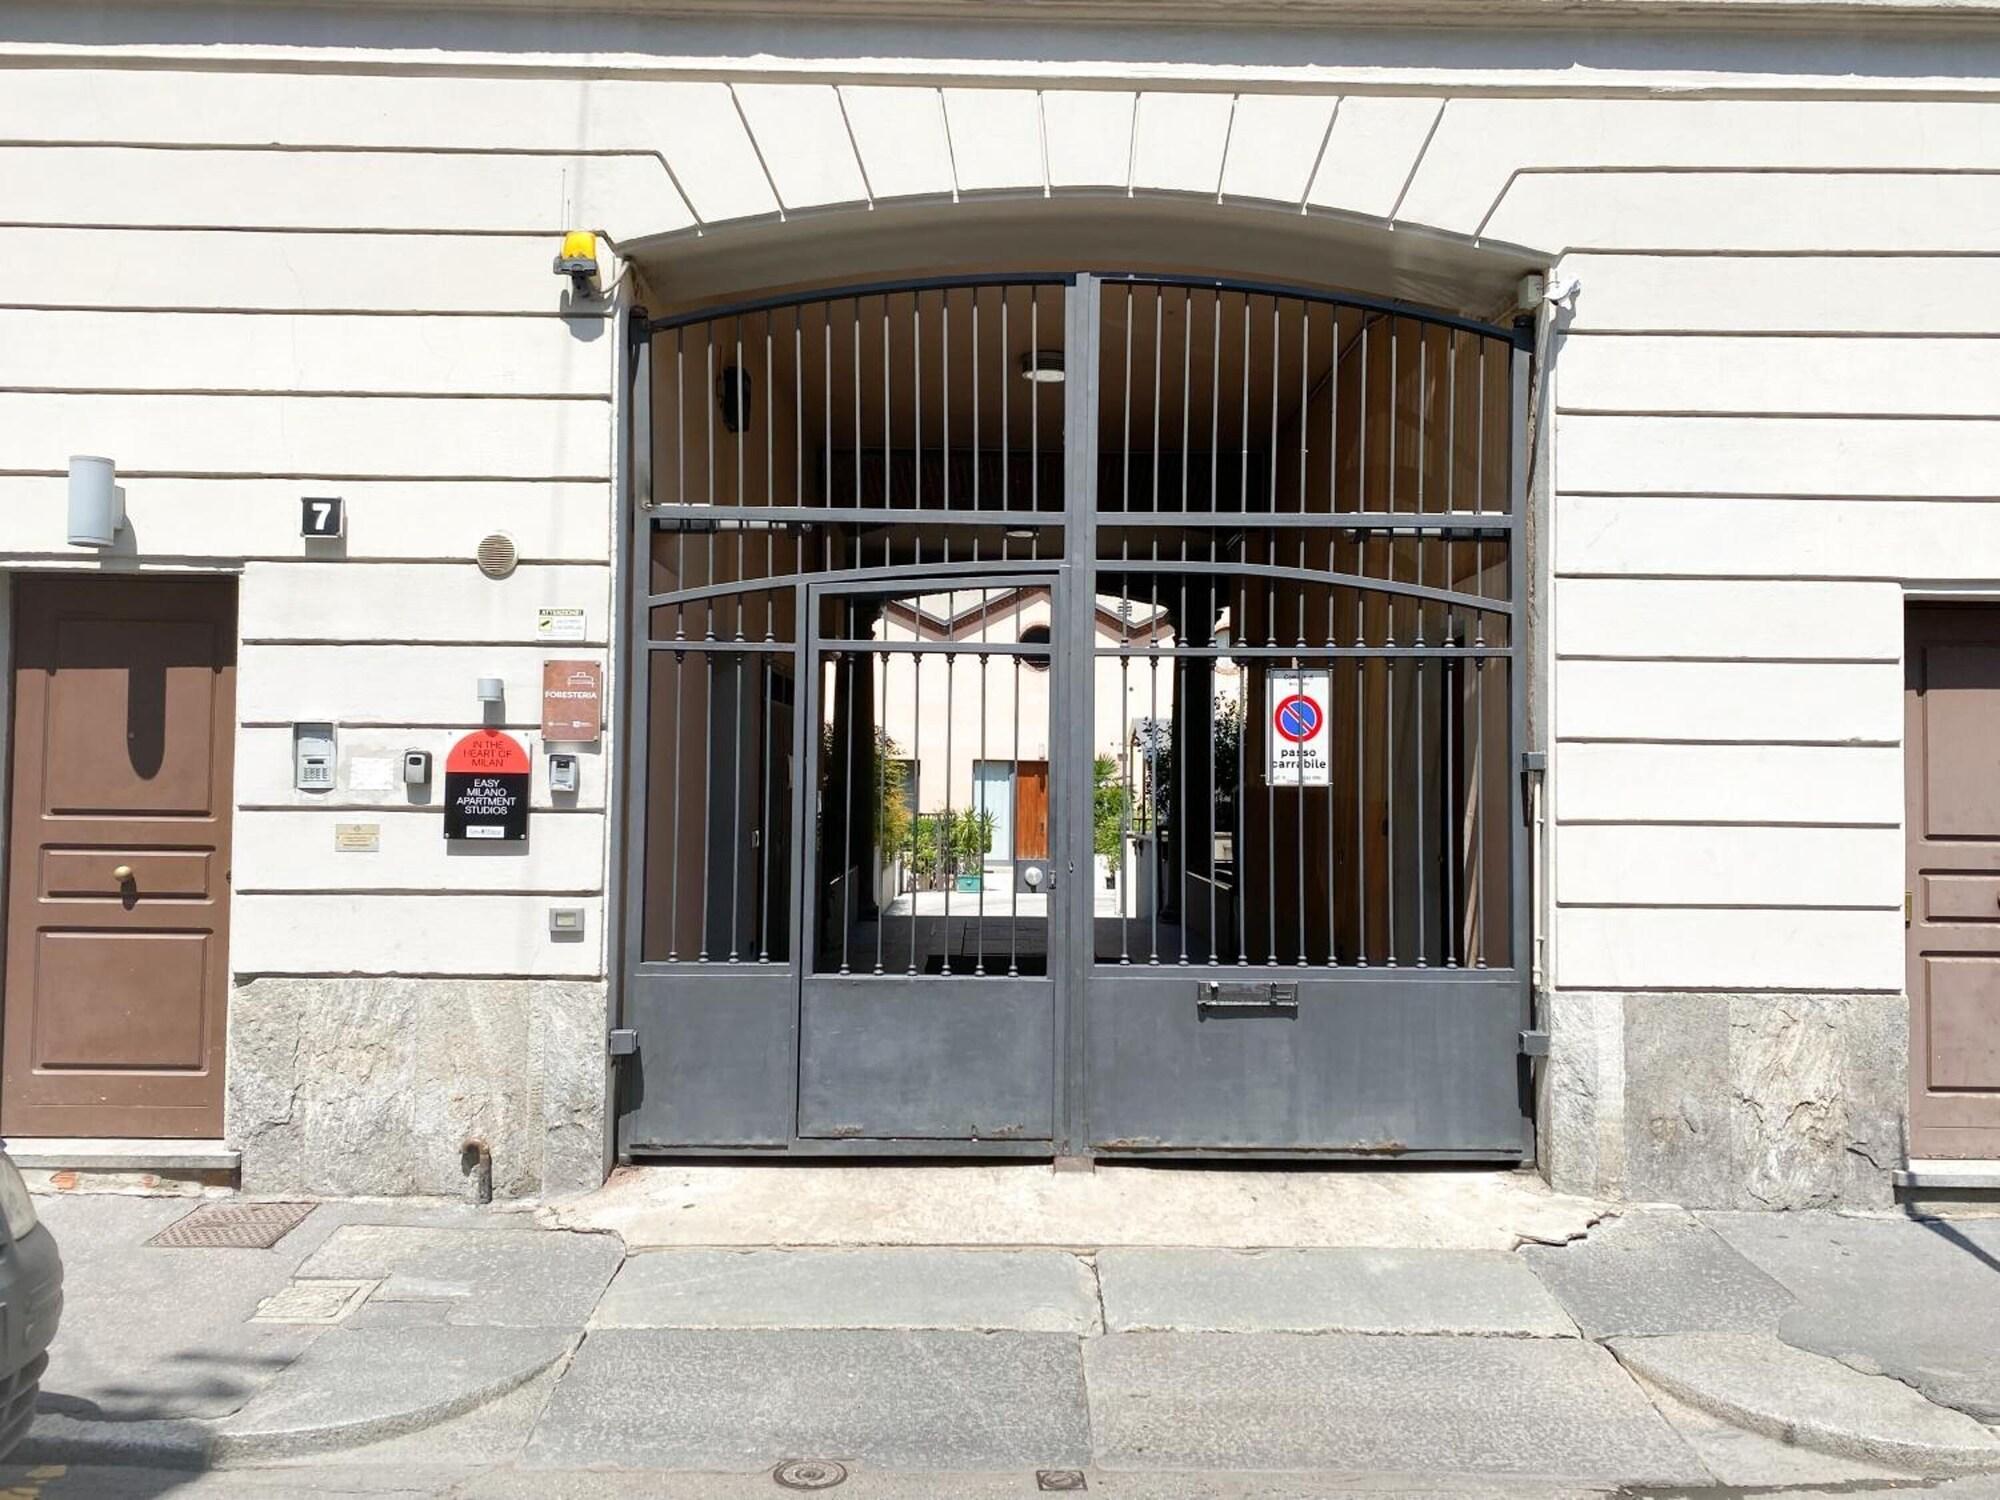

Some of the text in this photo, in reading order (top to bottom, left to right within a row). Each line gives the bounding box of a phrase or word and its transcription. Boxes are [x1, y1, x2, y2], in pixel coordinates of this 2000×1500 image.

[311, 503, 331, 530] 7
[545, 691, 597, 699] FORESTERIA
[473, 741, 504, 750] IN THE
[463, 749, 512, 758] HEART OF
[472, 759, 504, 768] MILAN
[474, 778, 500, 788] EASY
[466, 787, 508, 797] MILANO
[456, 796, 517, 806] APARTMENT
[464, 805, 508, 816] STUDIOS
